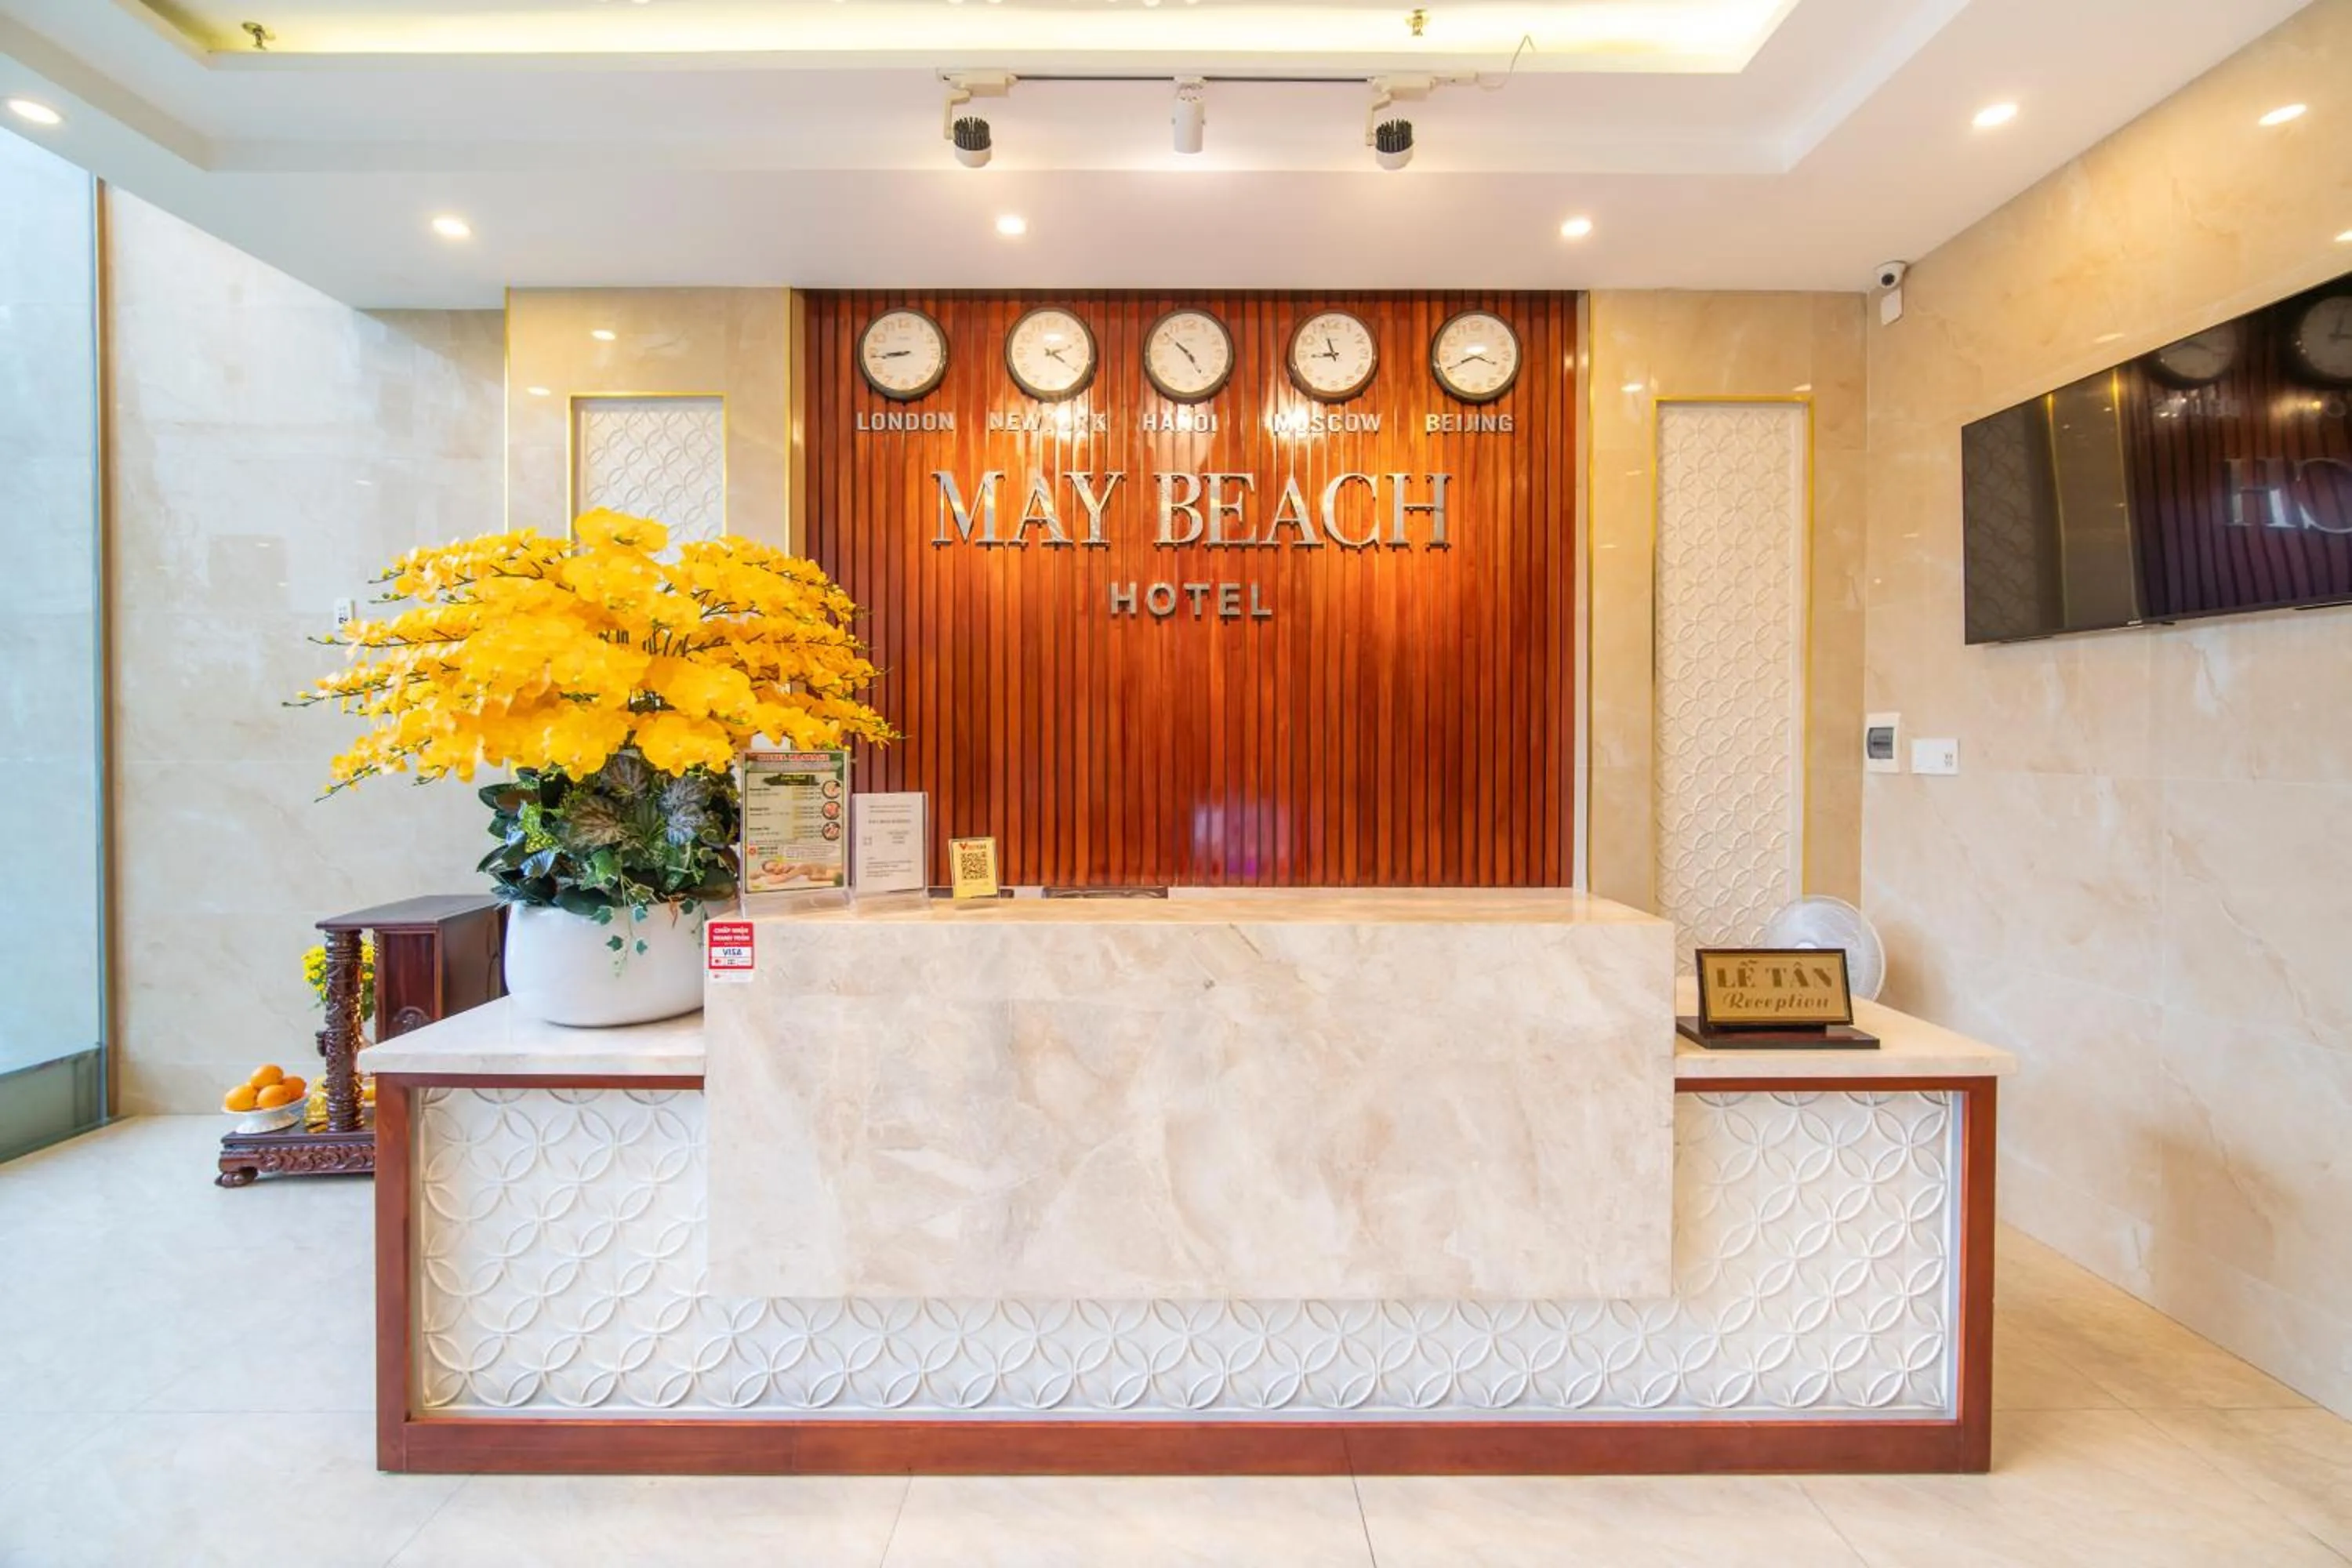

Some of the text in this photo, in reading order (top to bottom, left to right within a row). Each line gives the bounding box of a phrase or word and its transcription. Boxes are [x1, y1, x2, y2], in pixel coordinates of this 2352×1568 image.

[856, 412, 955, 431] LONDON
[989, 412, 1040, 431] NEW
[1425, 412, 1515, 432] BEIJING
[931, 471, 1451, 550] MAY BEACH
[1109, 582, 1272, 618] HOTEL
[1765, 961, 1833, 988] TÂN
[1722, 992, 1829, 1012] Reception
